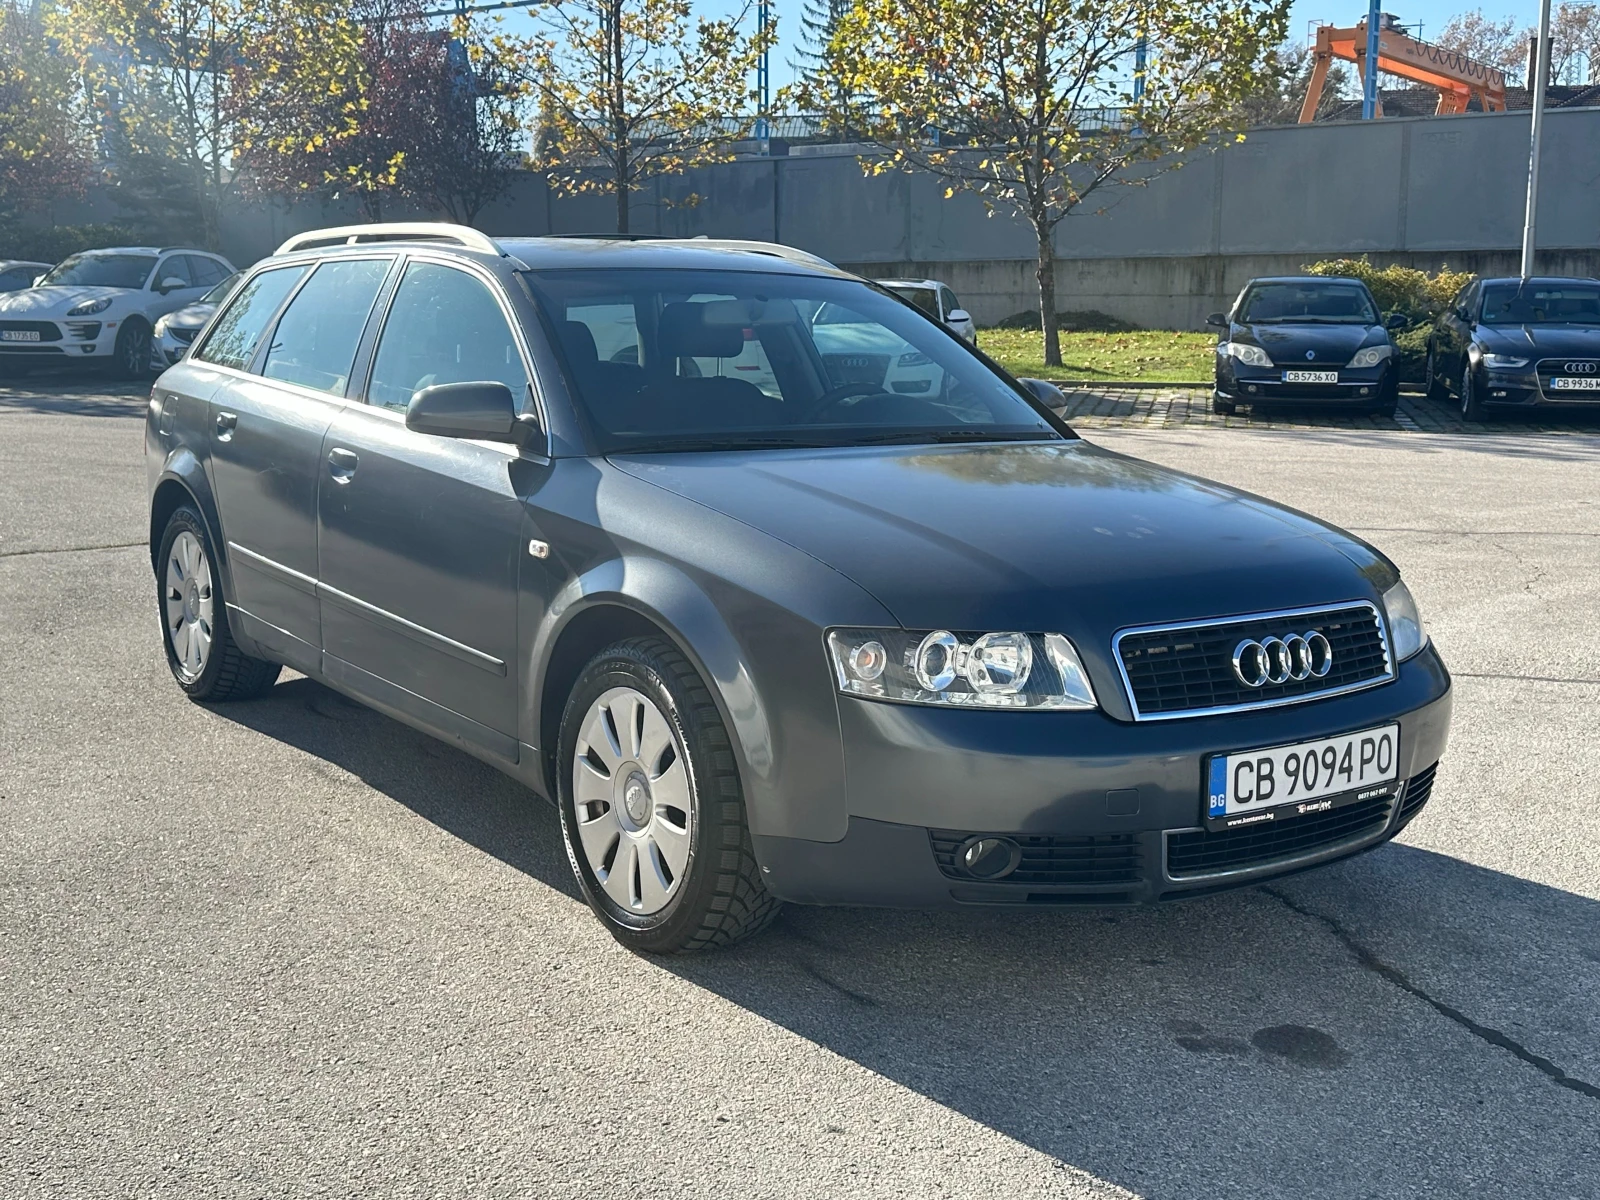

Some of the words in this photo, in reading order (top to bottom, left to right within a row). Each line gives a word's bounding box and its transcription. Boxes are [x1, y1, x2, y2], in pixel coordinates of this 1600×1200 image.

[1287, 372, 1300, 381] CB
[1301, 372, 1323, 381] 5736
[1324, 373, 1336, 382] XO
[1557, 379, 1570, 388] CB
[1571, 379, 1594, 388] 9936
[1233, 757, 1276, 805] CB
[1283, 741, 1354, 797] 9094
[1359, 733, 1393, 781] PO
[1210, 793, 1225, 809] BG
